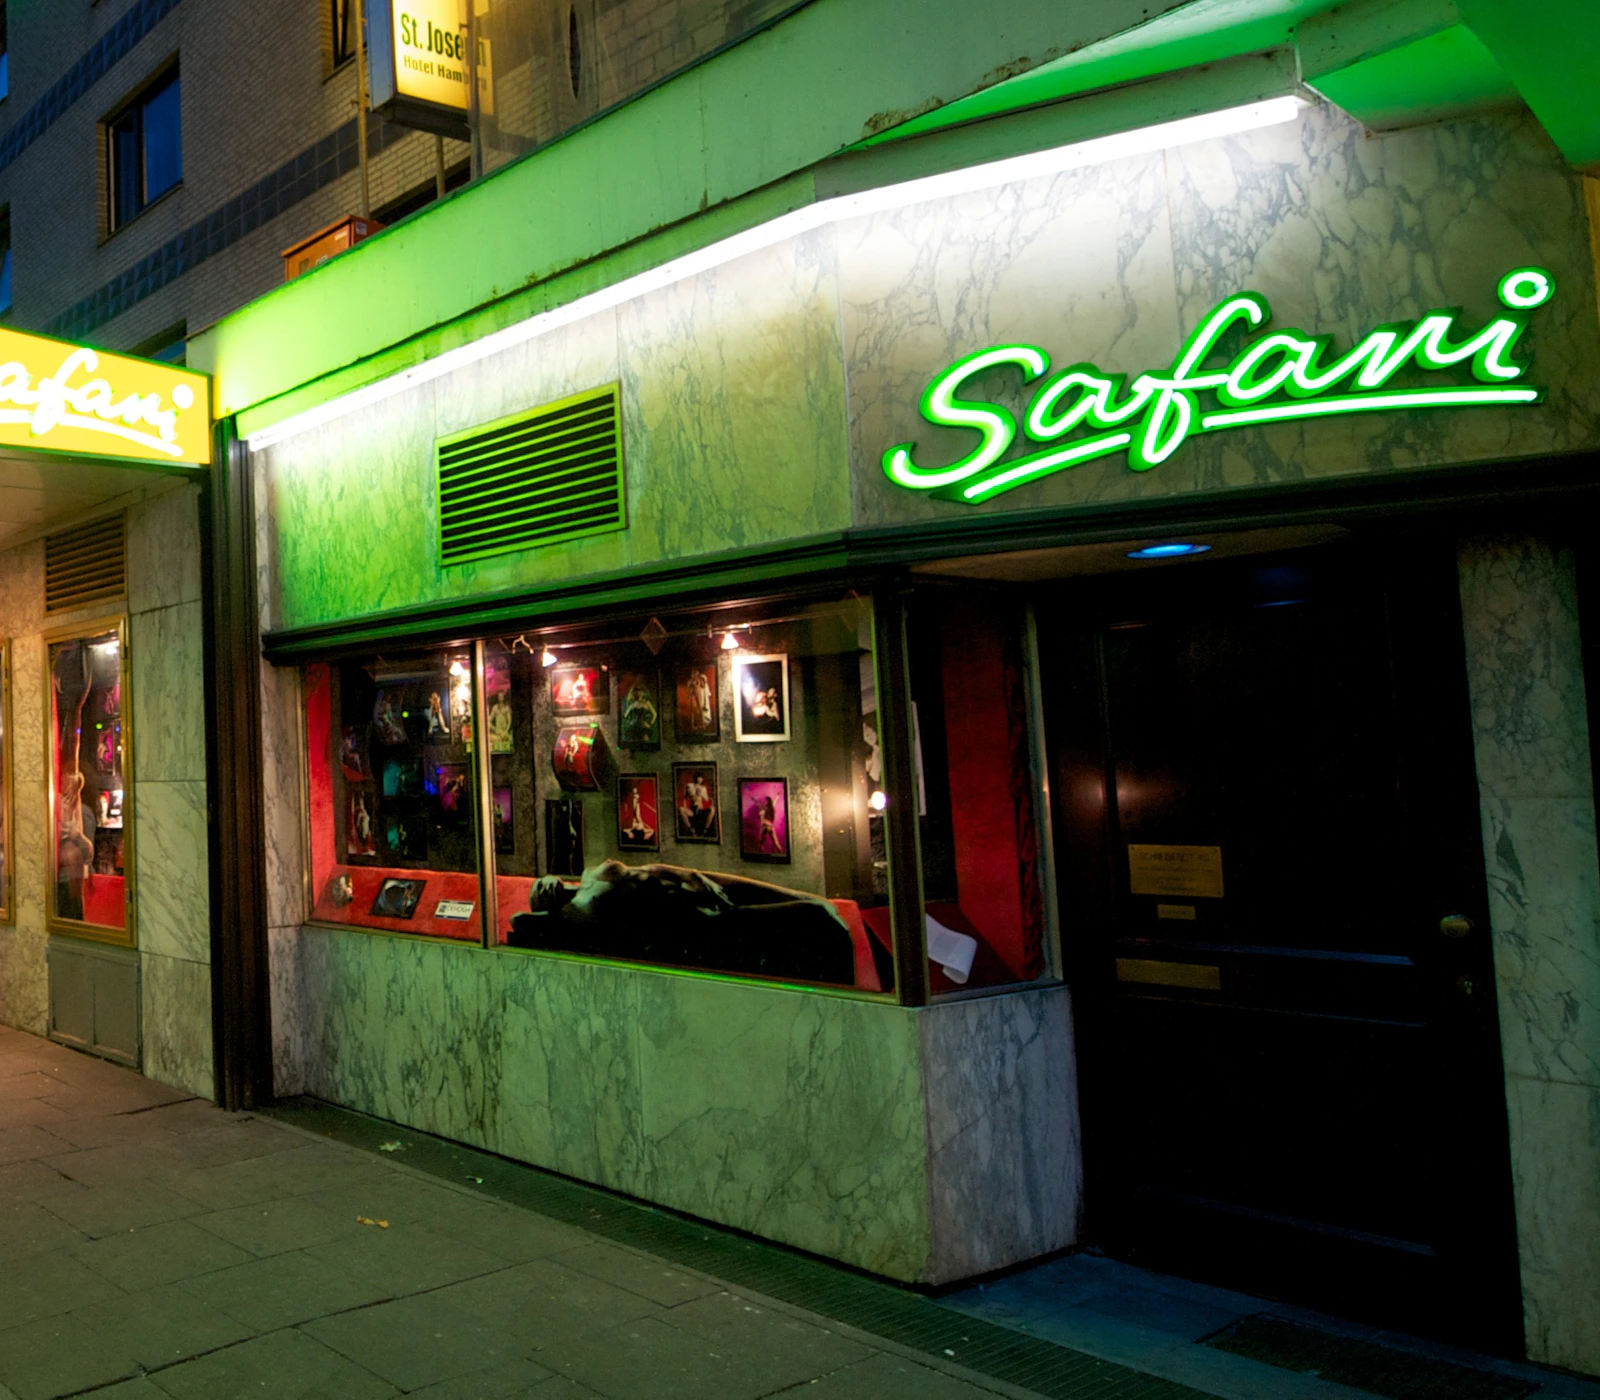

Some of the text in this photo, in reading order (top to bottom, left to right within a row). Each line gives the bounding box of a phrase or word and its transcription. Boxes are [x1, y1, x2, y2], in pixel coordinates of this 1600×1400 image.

[400, 13, 487, 67] St. Joseh
[403, 55, 434, 76] Hotel
[883, 266, 1555, 490] Safari
